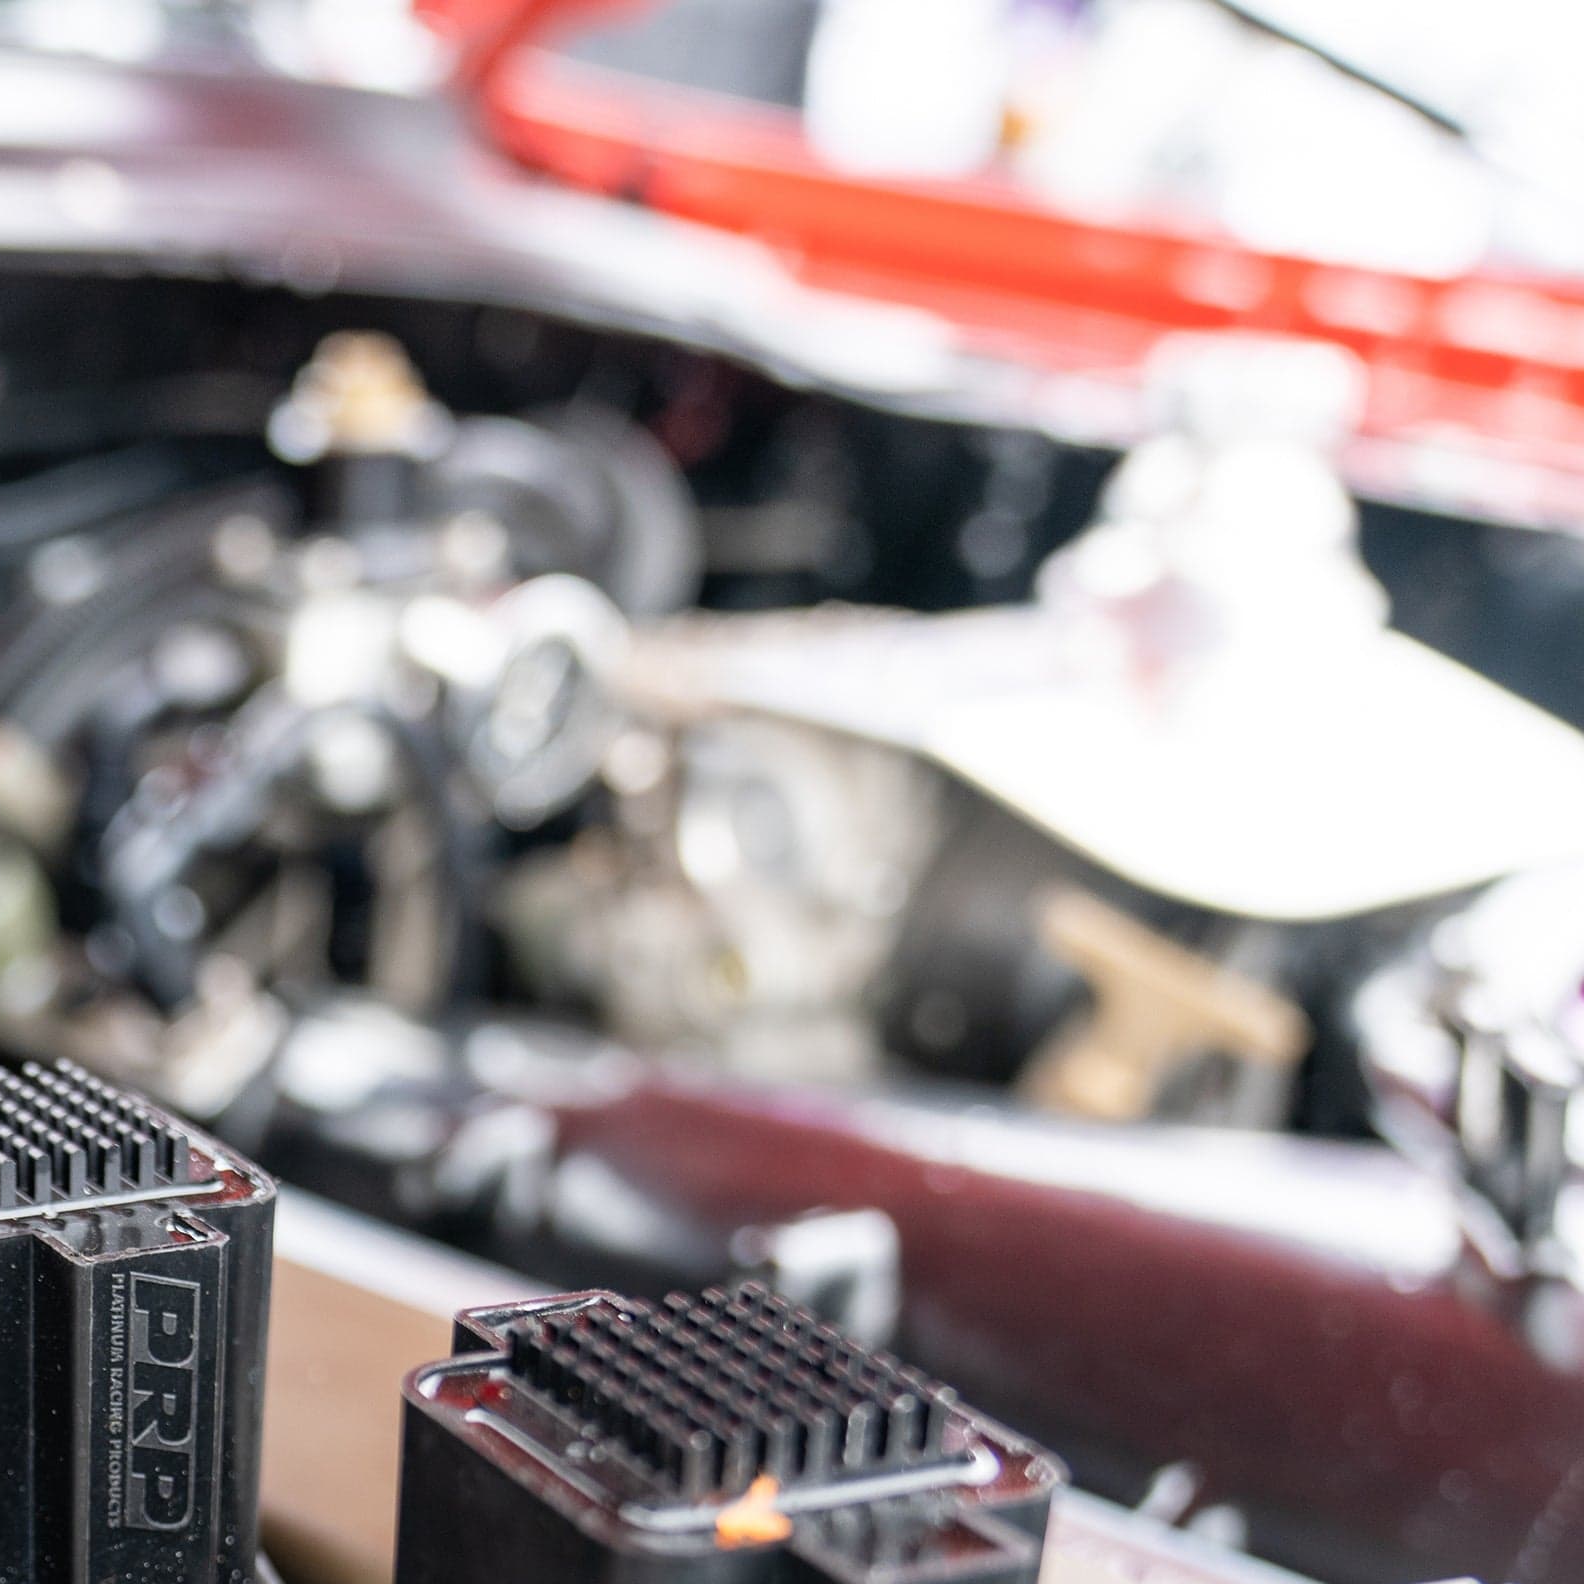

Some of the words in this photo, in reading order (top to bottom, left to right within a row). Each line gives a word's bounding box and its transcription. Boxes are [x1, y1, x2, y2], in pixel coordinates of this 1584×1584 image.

[110, 1272, 125, 1363] PLATINUM
[110, 1367, 124, 1435] RACING
[128, 1271, 201, 1530] PRP
[108, 1439, 123, 1530] PRODUCTS
